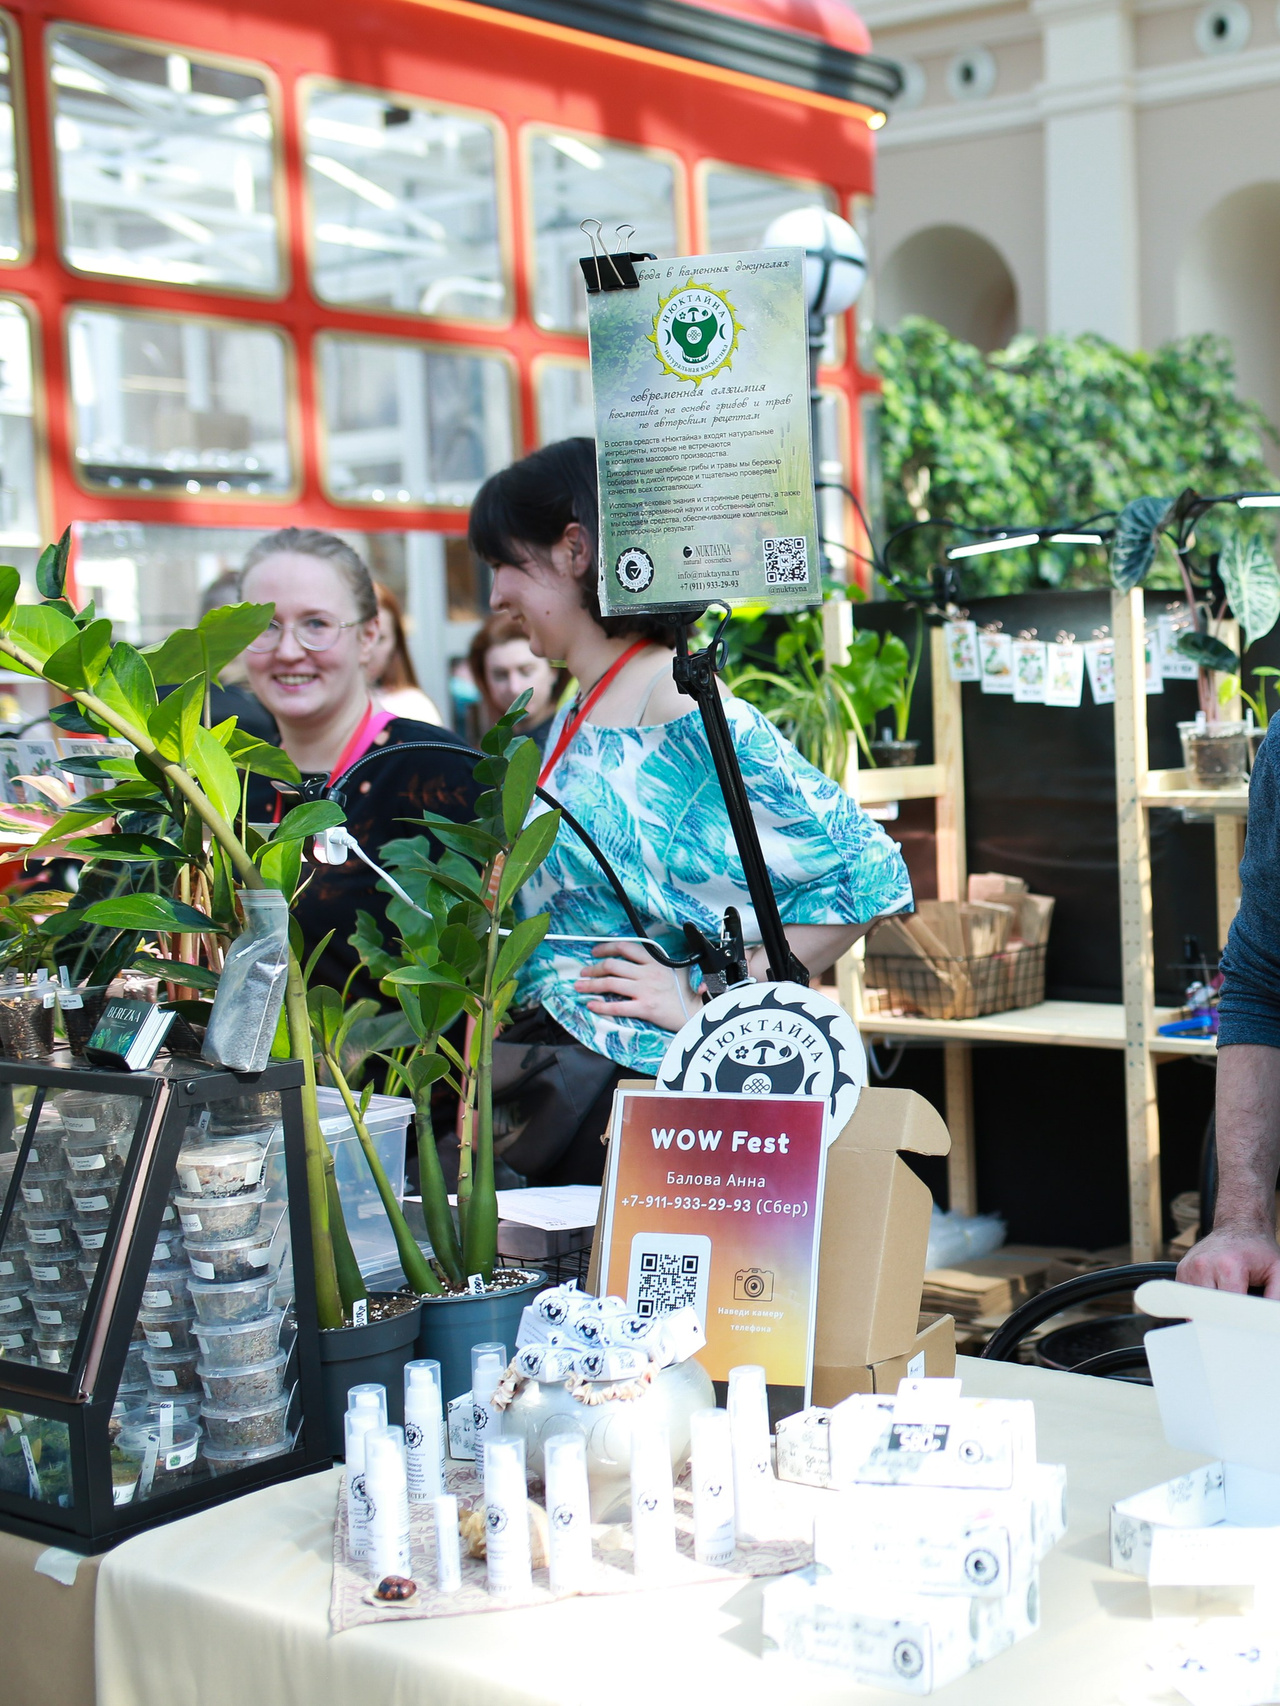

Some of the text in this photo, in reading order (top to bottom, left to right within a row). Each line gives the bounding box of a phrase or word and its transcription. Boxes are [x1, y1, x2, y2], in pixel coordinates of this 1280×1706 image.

[679, 264, 730, 277] каменных
[735, 260, 790, 274] джунглях
[662, 294, 726, 323] НЮКТАЙНА
[664, 344, 729, 373] натуральная косметика
[631, 383, 766, 406] современная алхимия
[609, 405, 659, 420] косметика
[681, 400, 711, 413] основе
[716, 397, 749, 414] грибов
[765, 394, 793, 410] трав
[654, 414, 707, 430] авторским
[711, 413, 760, 428] рецептам
[634, 438, 660, 446] средств
[661, 434, 702, 443] «Нюктайна»
[704, 432, 727, 440] входят
[729, 428, 774, 438] натуральные
[605, 448, 648, 457] ингредиенты,
[650, 445, 677, 453] которые
[688, 441, 731, 450] встречаются
[611, 457, 644, 465] косметике
[646, 454, 679, 462] массового
[681, 451, 729, 460] производства.
[607, 469, 654, 478] Дикорастущие
[655, 465, 687, 474] целебные
[689, 463, 709, 471] грибы
[717, 462, 737, 470] травы
[751, 459, 781, 467] бережно
[607, 478, 639, 487] собираем
[646, 475, 665, 484] дикой
[667, 474, 694, 482] природе
[702, 471, 738, 480] тщательно
[740, 467, 778, 476] проверяем
[608, 488, 636, 496] качество
[654, 483, 703, 492] составляющих.
[644, 499, 671, 507] вековые
[702, 494, 739, 502] старинные
[741, 492, 773, 500] рецепты,
[610, 510, 640, 518] открытия
[641, 507, 683, 516] современной
[711, 501, 755, 511] собственный
[683, 513, 741, 523] обеспечивающие
[743, 509, 788, 518] комплексный
[617, 528, 661, 537] долгосрочный
[664, 525, 695, 533] результат.
[695, 544, 732, 558] NUKTAYNA
[677, 569, 740, 580] info@nuktayna.ru
[689, 582, 706, 591] (911)
[707, 580, 739, 589] 933-29-93
[768, 586, 807, 595] @nuktayna
[106, 1006, 141, 1023] BEREZKA
[700, 1019, 824, 1064] НЮКТАЙНА
[651, 1127, 790, 1154] WOW Fest
[666, 1171, 767, 1188] Балова Анна
[621, 1194, 809, 1218] +7-911-933-29-93 (Сбер)
[717, 1306, 784, 1319] Наведи камеру
[730, 1323, 772, 1334] телефона
